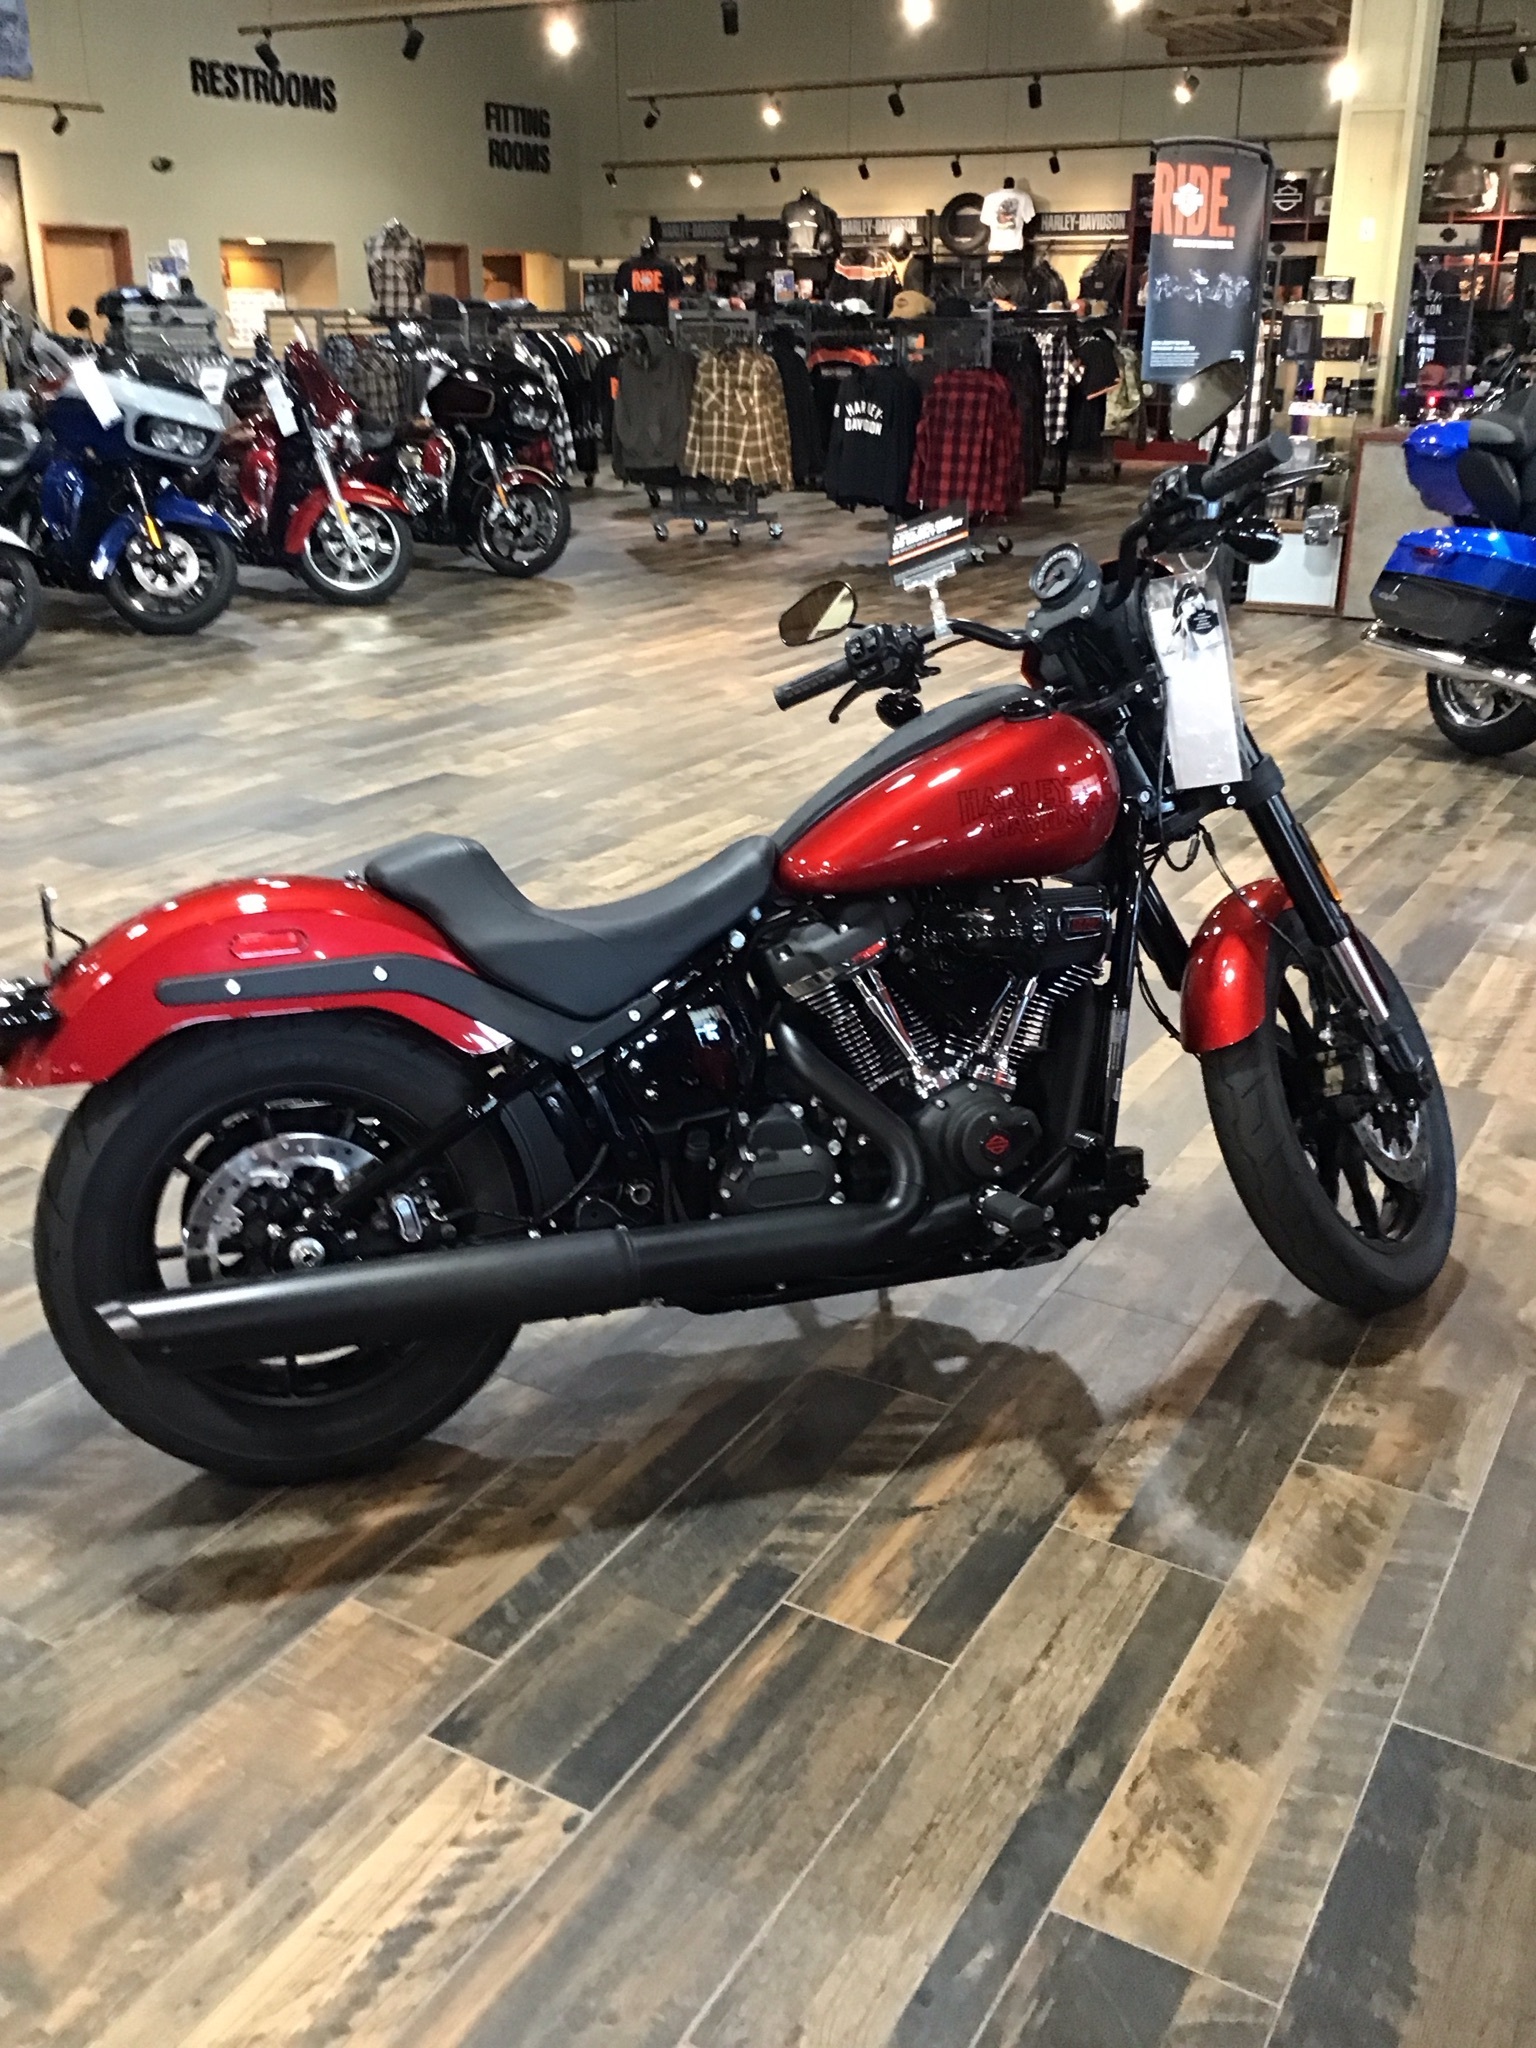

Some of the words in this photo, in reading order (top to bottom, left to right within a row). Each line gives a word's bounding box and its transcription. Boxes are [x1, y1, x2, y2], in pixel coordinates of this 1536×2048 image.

[190, 57, 338, 113] RESTROOMS
[485, 101, 551, 138] FITTING
[488, 137, 551, 174] ROOMS
[1041, 212, 1126, 232] HARLEY-DAVIDSON
[957, 776, 1072, 826] HARLEY
